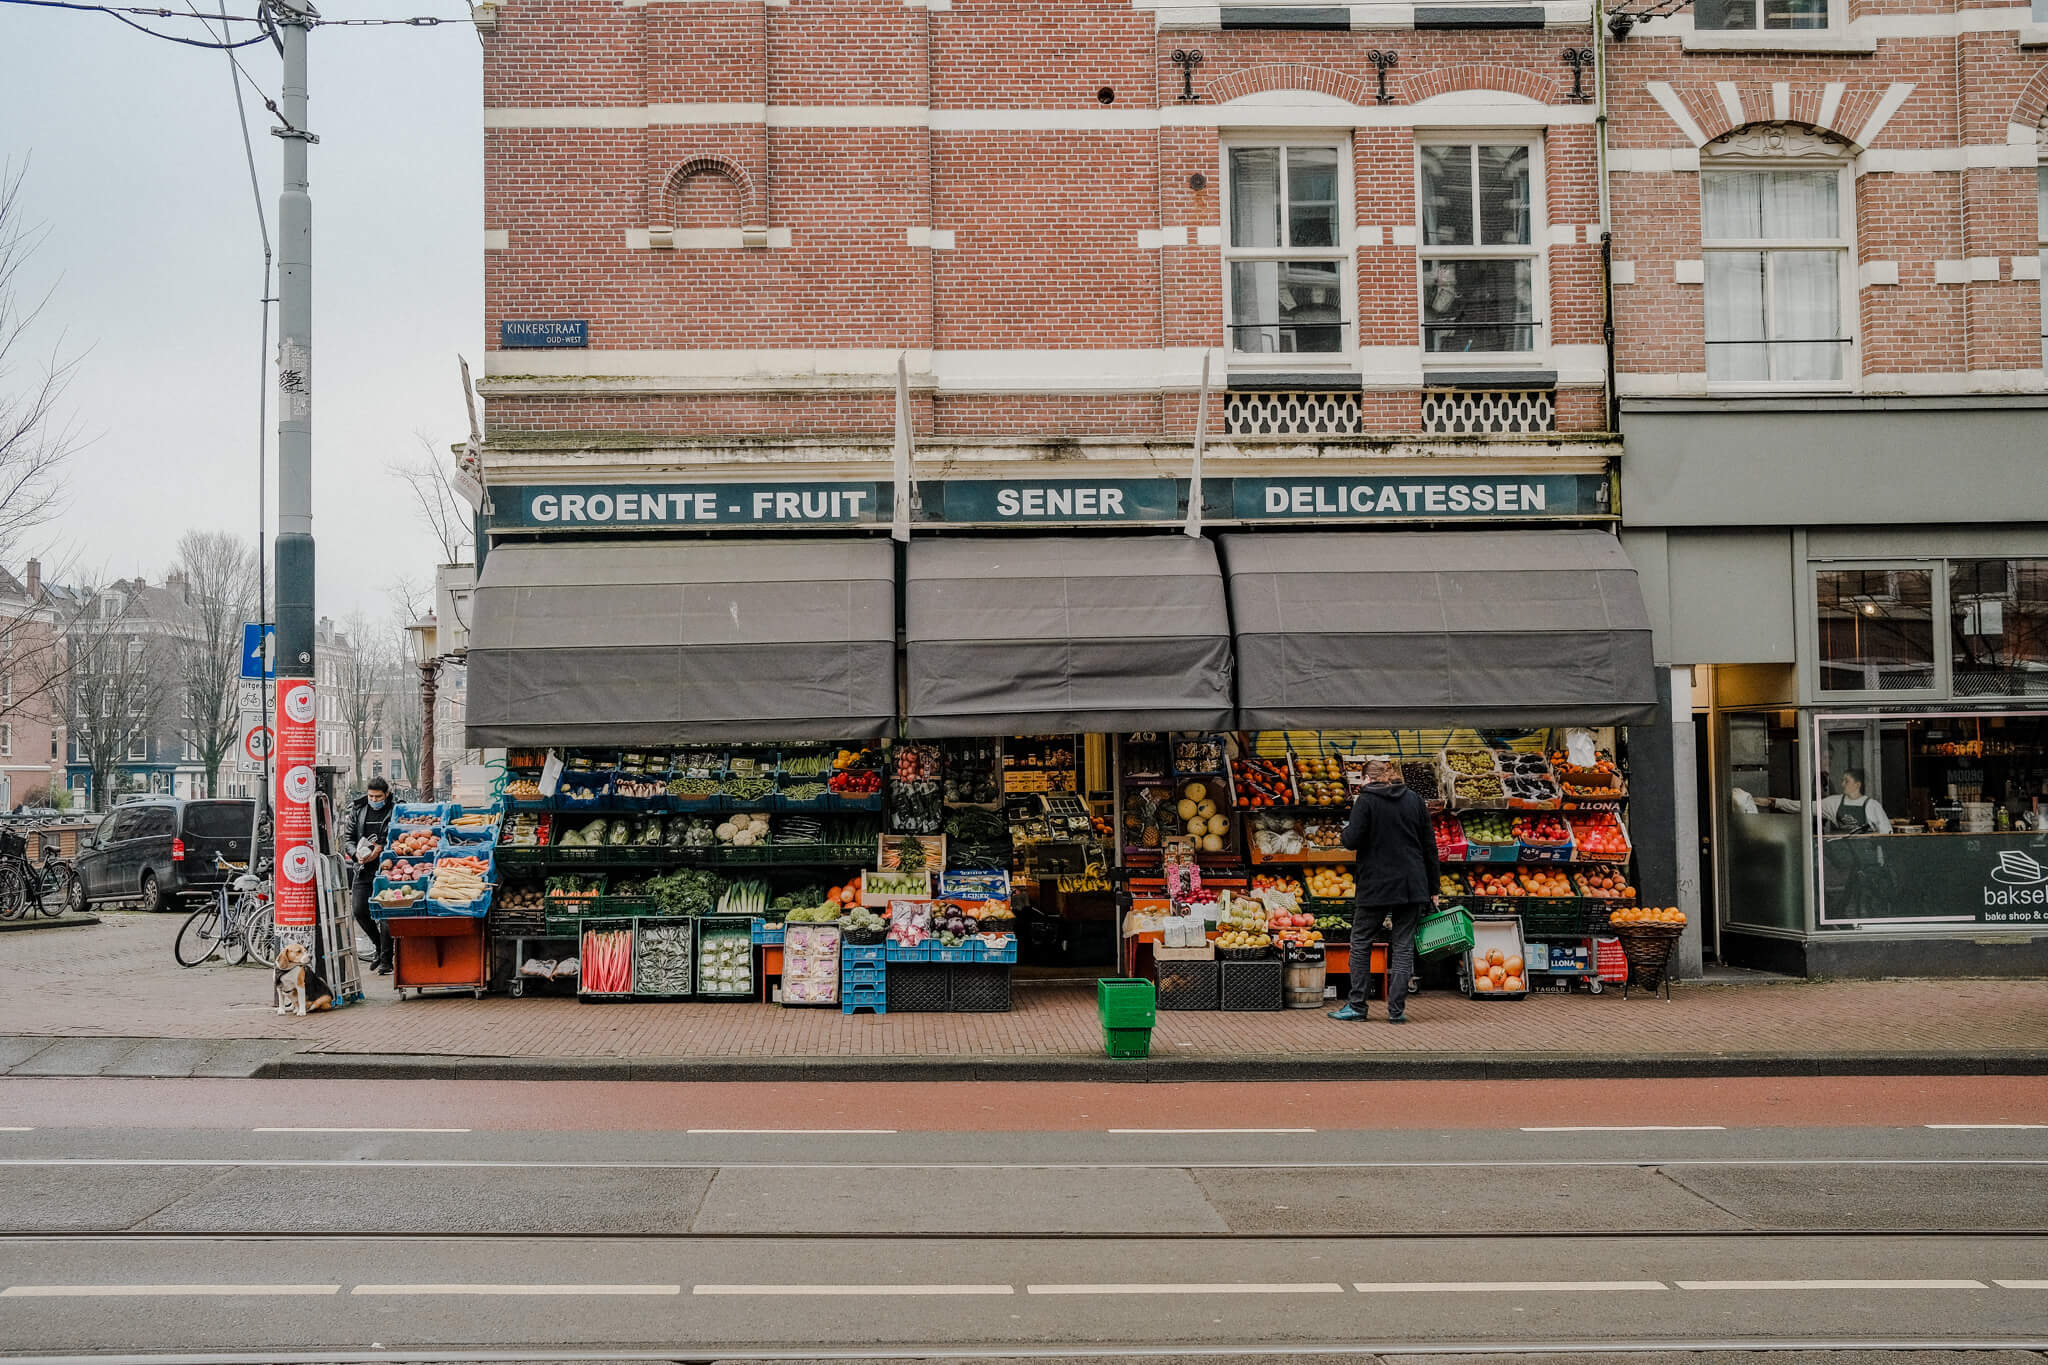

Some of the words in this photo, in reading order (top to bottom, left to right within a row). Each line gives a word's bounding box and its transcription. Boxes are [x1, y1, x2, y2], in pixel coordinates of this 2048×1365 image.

[507, 323, 582, 334] KINKERSTRAAT
[546, 336, 582, 344] OUD-WEST
[996, 488, 1125, 516] SENER
[1265, 484, 1545, 513] DELICATESSEN
[531, 493, 717, 522] GROENTE
[728, 505, 741, 513] -
[753, 491, 867, 519] FRUIT
[252, 736, 272, 749] 30
[1580, 802, 1620, 810] LLONA
[1985, 912, 2007, 921] bake
[2009, 912, 2032, 922] shop
[2033, 910, 2042, 919] &
